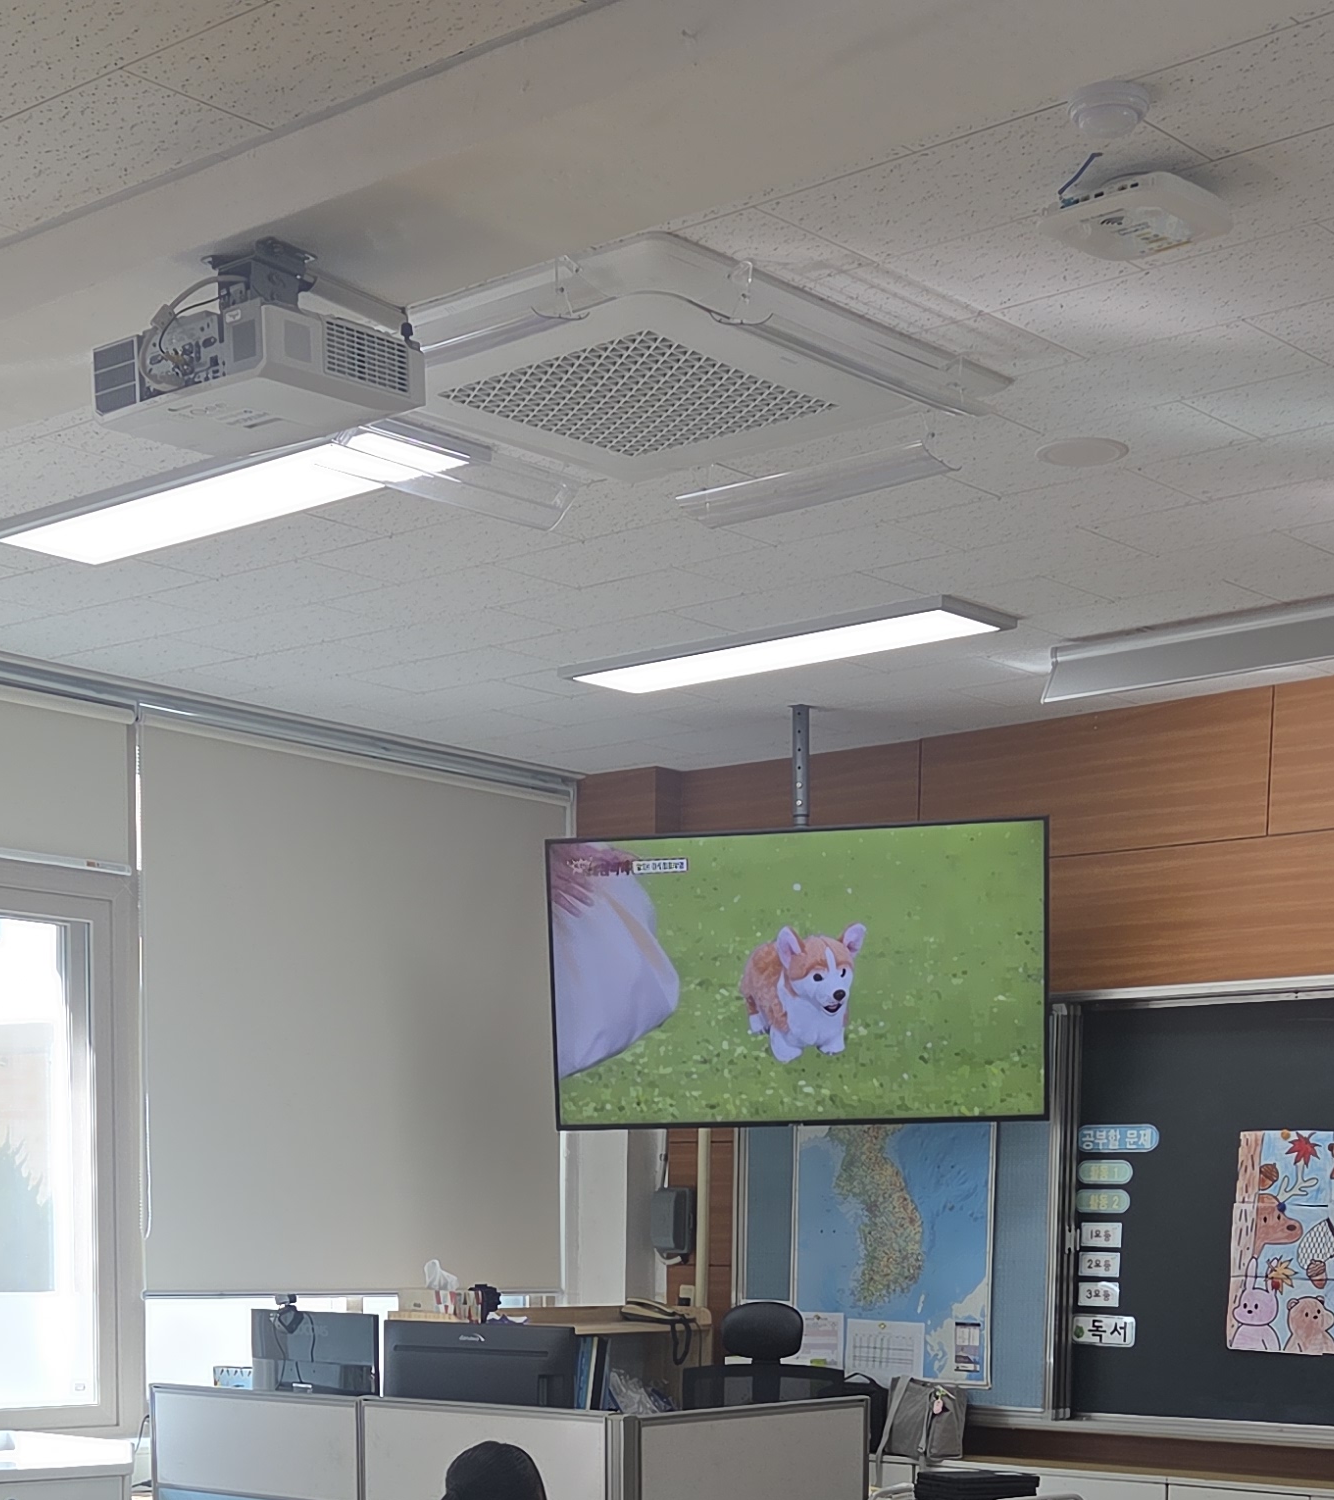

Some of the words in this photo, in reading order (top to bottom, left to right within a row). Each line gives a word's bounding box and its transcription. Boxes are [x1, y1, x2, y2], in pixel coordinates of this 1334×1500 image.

[1081, 1128, 1120, 1150] 공부할
[1125, 1128, 1152, 1149] 문제
[1112, 1195, 1119, 1209] 2
[1087, 1319, 1128, 1344] 독서
